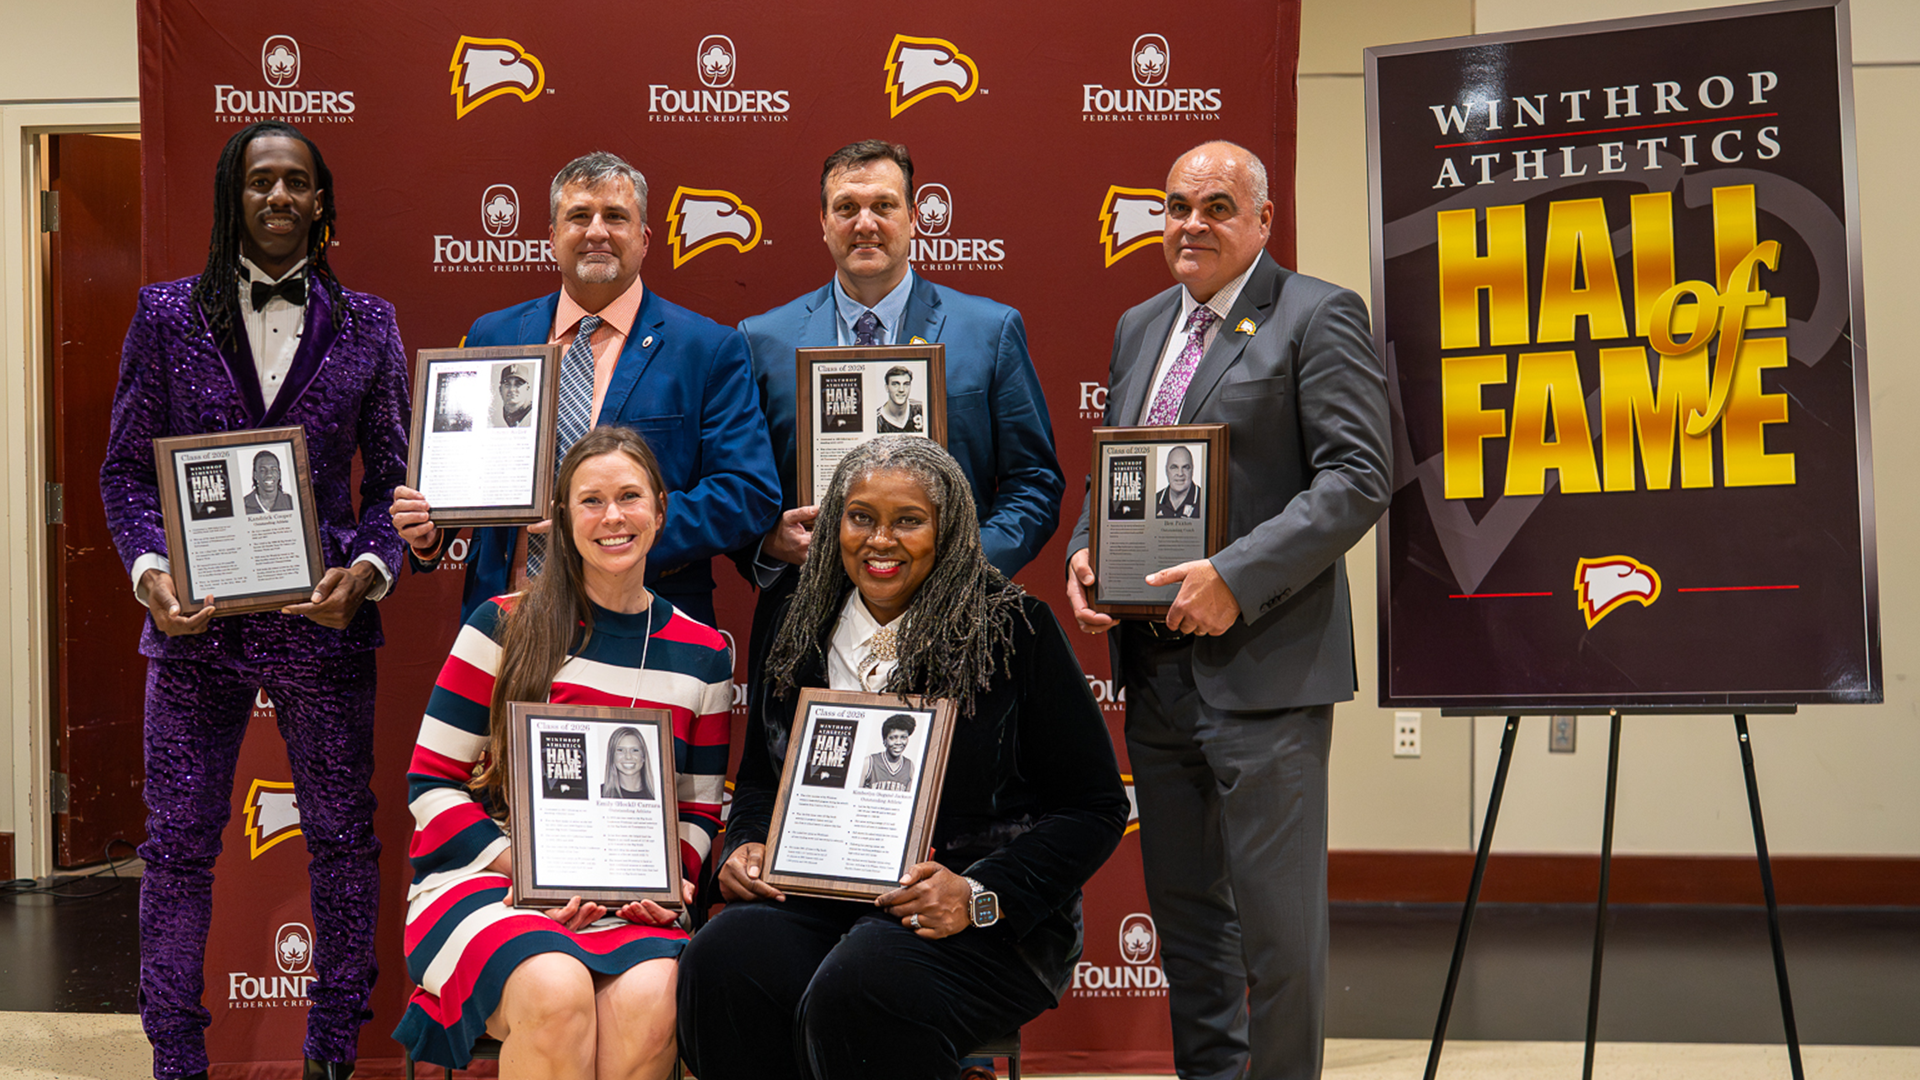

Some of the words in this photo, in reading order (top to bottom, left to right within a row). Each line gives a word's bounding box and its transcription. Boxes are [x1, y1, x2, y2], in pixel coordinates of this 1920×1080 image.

[214, 85, 355, 113] FOUNDERS
[648, 84, 790, 113] FOUNDERS
[1081, 84, 1222, 112] FOUNDERS
[1428, 71, 1779, 135] WINTHROP
[271, 115, 313, 123] CREDIT
[318, 115, 354, 123] UNION
[1082, 114, 1133, 122] FEDERAL
[1138, 114, 1180, 122] CREDIT
[1185, 113, 1220, 121] UNION
[1432, 126, 1781, 189] ATHLETICS
[433, 235, 557, 263] FOUNDER
[921, 263, 963, 271] CREDIT
[969, 263, 1004, 271] UNION
[1437, 184, 1787, 349] HALL
[1649, 239, 1782, 436] of
[826, 388, 857, 402] HALL
[826, 400, 857, 415] FAME
[1441, 337, 1796, 499] FAME
[181, 454, 201, 462] Class
[1126, 446, 1134, 454] of
[191, 474, 224, 490] HALL
[1113, 472, 1141, 486] HALL
[193, 486, 227, 503] FAME
[1113, 486, 1141, 501] FAME
[815, 708, 835, 716] Class
[846, 711, 865, 719] 2026
[815, 735, 849, 751] HALL
[546, 748, 581, 764] HALL
[812, 749, 847, 768] FAME
[547, 763, 582, 780] FAME
[1072, 962, 1170, 989] FOUND
[228, 972, 318, 999] FOUND
[1072, 990, 1122, 998] FEDERAL
[229, 1000, 279, 1009] FEDERAL
